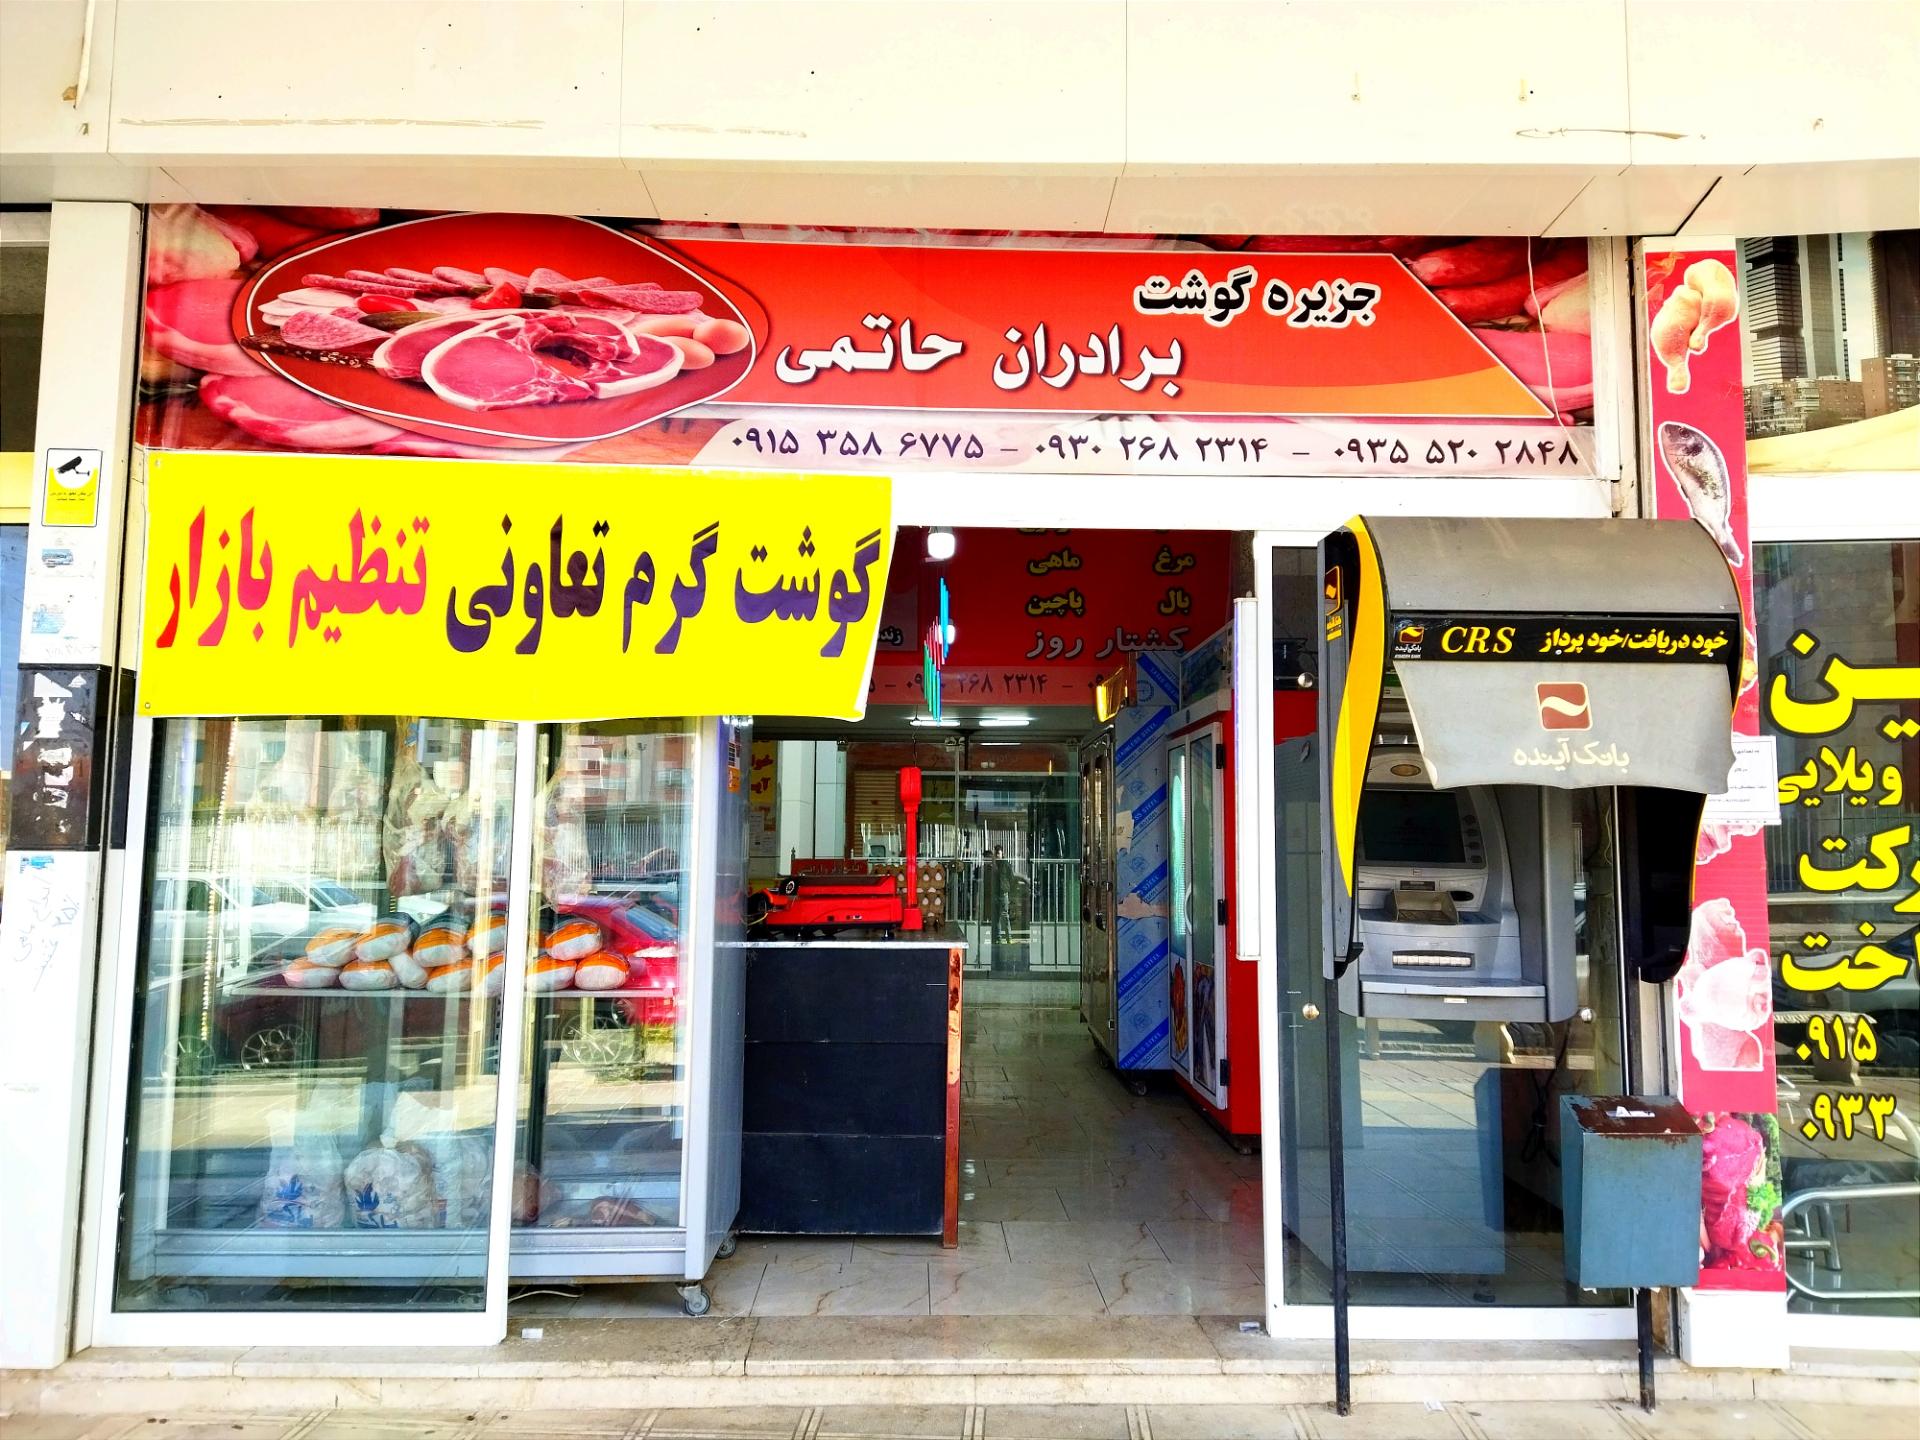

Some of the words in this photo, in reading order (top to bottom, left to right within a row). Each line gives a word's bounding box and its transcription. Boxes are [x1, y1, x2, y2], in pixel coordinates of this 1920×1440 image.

[1134, 265, 1257, 327] گوشت
[1264, 279, 1381, 328] جزیره
[774, 312, 965, 384] حاتمی
[992, 322, 1183, 399] برادران
[732, 426, 800, 456] ۰۹۱۵
[817, 429, 882, 457] ۳۵۸
[900, 431, 984, 459] ۶۷۷۵
[1035, 434, 1102, 461] ۰۹۳۰
[1121, 434, 1179, 461] ۲۶۸
[1195, 437, 1269, 464] ۲۳۱۴
[1334, 437, 1410, 465] ۰۹۳۵
[1426, 438, 1478, 465] ۵۲۰
[1495, 438, 1579, 466] ۲۸۴۸
[156, 505, 273, 648] بازار
[288, 508, 429, 649] تنظیم
[446, 512, 610, 655] تعاونی
[1029, 550, 1081, 574] ماهی
[1154, 547, 1194, 573] مرغ
[622, 520, 720, 654] گرم
[735, 525, 882, 657] گوشت
[1027, 590, 1083, 615] پاچین
[1160, 590, 1191, 614] بال
[878, 626, 902, 644] زند
[1027, 631, 1083, 658] روز
[1096, 627, 1189, 658] کشتار
[1441, 626, 1516, 654] CRS
[1539, 627, 1585, 653] پرداز
[1691, 629, 1729, 655] خود
[958, 676, 993, 695] ۲۶۸
[1003, 675, 1048, 694] ۲۳۱۴
[1770, 632, 1920, 740] ین
[1513, 737, 1571, 772] آینده
[1573, 741, 1631, 774] بانک
[1778, 746, 1903, 806] ویلایی
[1799, 825, 1920, 913] رکت
[1781, 921, 1920, 991] خت
[1796, 1014, 1879, 1062] ۰۹۱۵
[1800, 1092, 1897, 1142] ۰۹۳۳
